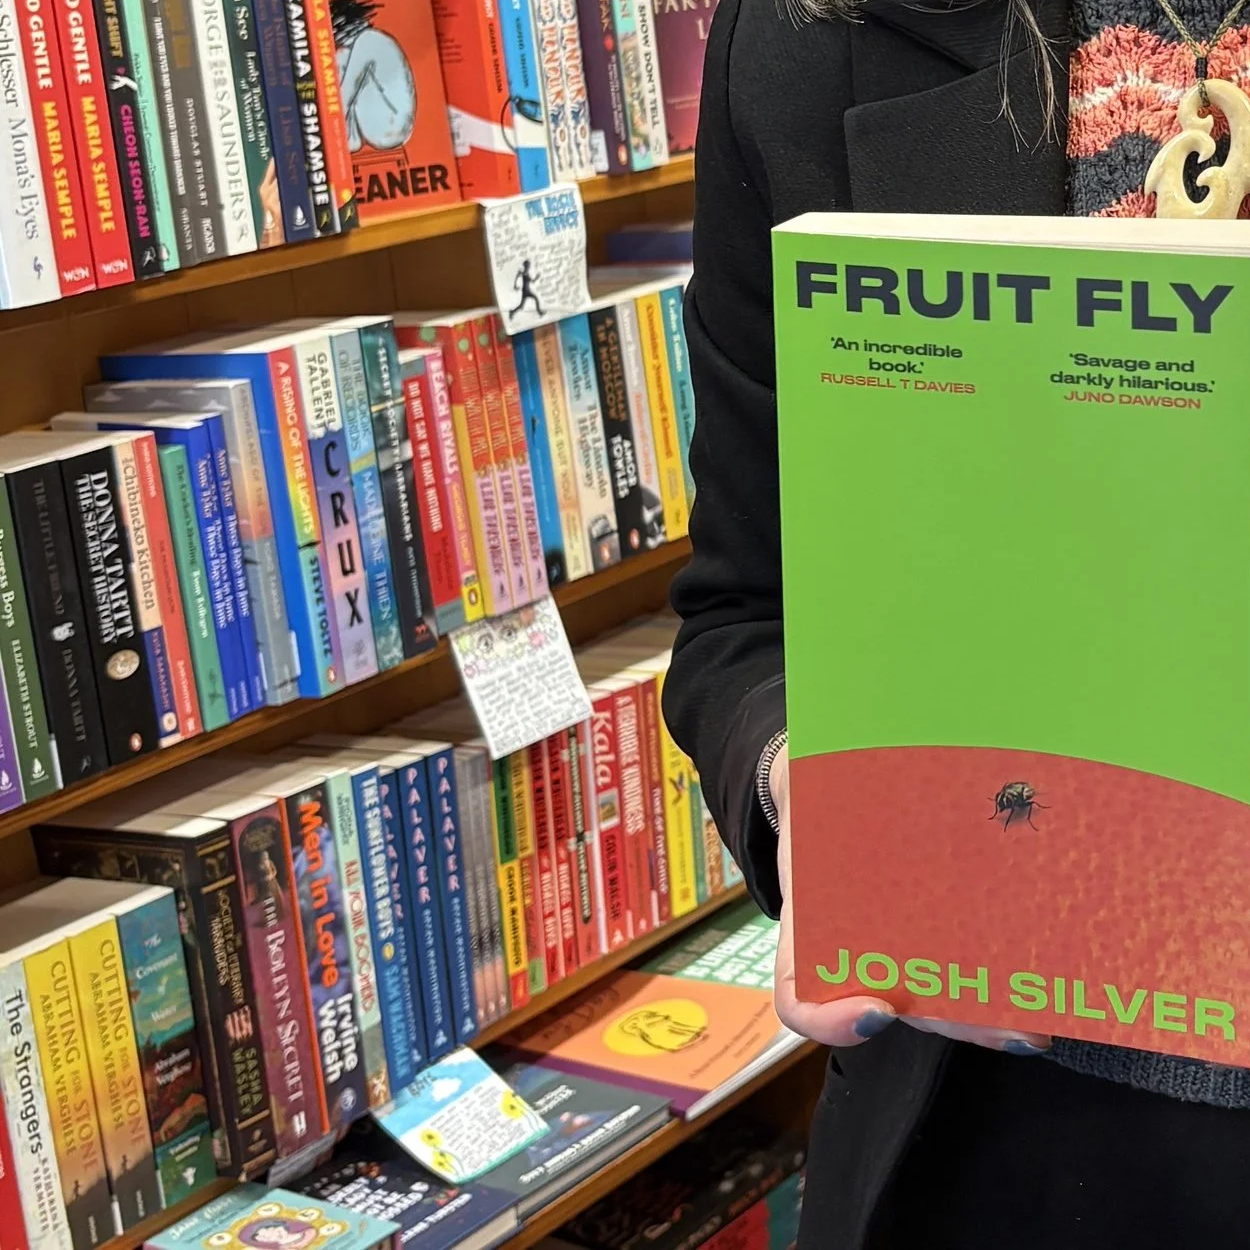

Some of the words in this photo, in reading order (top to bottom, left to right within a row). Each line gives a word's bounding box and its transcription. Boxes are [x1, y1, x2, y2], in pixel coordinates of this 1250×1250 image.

[29, 14, 53, 90] GENTLE
[68, 9, 93, 87] GENTLE
[637, 5, 651, 48] SHOW
[316, 28, 341, 116] SHAMSIE
[642, 50, 656, 100] DON'T
[42, 100, 65, 167] MARIA
[80, 95, 104, 160] MARIA
[647, 100, 661, 128] TELL
[8, 116, 37, 190] Mona's
[213, 89, 249, 223] SAUNDERS
[302, 101, 331, 207] SHAMSIE
[15, 193, 40, 241] Eyes
[53, 166, 77, 241] SEMPLE
[91, 160, 116, 234] SEMPLE
[795, 259, 1051, 325] FRUIT
[1075, 276, 1236, 334] FLY
[820, 372, 897, 389] RUSSELL
[899, 378, 910, 390] T
[914, 379, 977, 394] DAVIES
[863, 339, 964, 359] incredible
[1049, 370, 1115, 390] darkly
[1068, 352, 1152, 372] 'Savage
[1154, 359, 1195, 374] and
[306, 354, 326, 428] TALLENT
[316, 351, 337, 424] GABRIEL
[1063, 390, 1116, 404] JUNO
[1118, 393, 1202, 410] DAWSON
[610, 434, 630, 499] TOWLES
[622, 438, 637, 488] AMOR
[90, 469, 121, 557] DONNA
[107, 557, 135, 639] TARTT
[122, 467, 146, 546] Chibineko
[136, 548, 157, 612] Kitchen
[323, 440, 364, 628] CRUX
[1, 590, 15, 628] Boys
[12, 638, 30, 703] ELIZABETH
[22, 704, 39, 749] STROUT
[592, 708, 616, 788] Kala
[405, 767, 432, 904] PALAVER
[436, 756, 461, 892] PALAVER
[262, 895, 279, 928] THE
[297, 800, 324, 873] Men
[313, 912, 339, 989] Love
[50, 960, 82, 1064] CUTTING
[99, 938, 130, 1041] CUTTING
[265, 929, 293, 1021] BOLEYN
[815, 948, 991, 1004] JOSH
[1009, 971, 1237, 1041] SILVER
[6, 989, 24, 1036] The
[318, 999, 341, 1084] Welsh
[336, 992, 359, 1074] Irvine
[39, 993, 62, 1075] ABRAHAM
[53, 1076, 77, 1155] VERGHESE
[70, 1069, 84, 1095] FOR
[88, 970, 111, 1052] ABRAHAM
[101, 1052, 125, 1131] VERGHESE
[119, 1045, 132, 1071] FOR
[231, 1047, 252, 1117] WASLEY
[244, 1046, 264, 1109] SASHA
[277, 1020, 304, 1103] SECRET
[13, 1040, 46, 1155] Strangers
[122, 1074, 146, 1146] STONE
[73, 1100, 99, 1171] STONE
